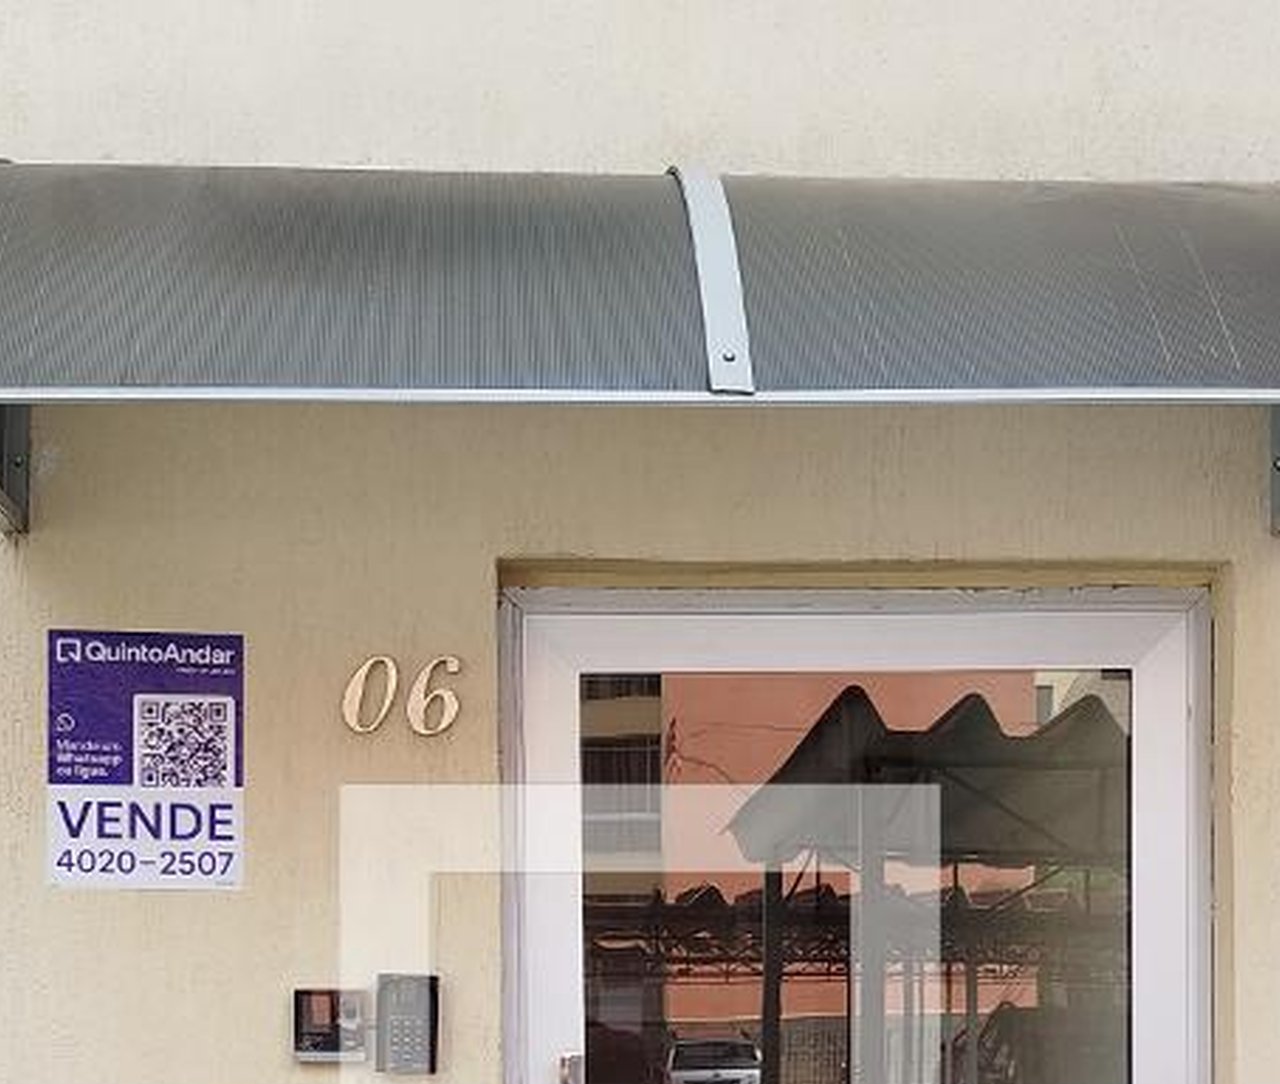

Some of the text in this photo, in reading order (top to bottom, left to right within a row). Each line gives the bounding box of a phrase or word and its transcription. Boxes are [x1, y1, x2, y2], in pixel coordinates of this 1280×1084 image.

[85, 641, 236, 664] QuintoAndar
[341, 654, 462, 736] 06
[57, 801, 234, 841] VENDE
[56, 849, 234, 876] 4020-2507
